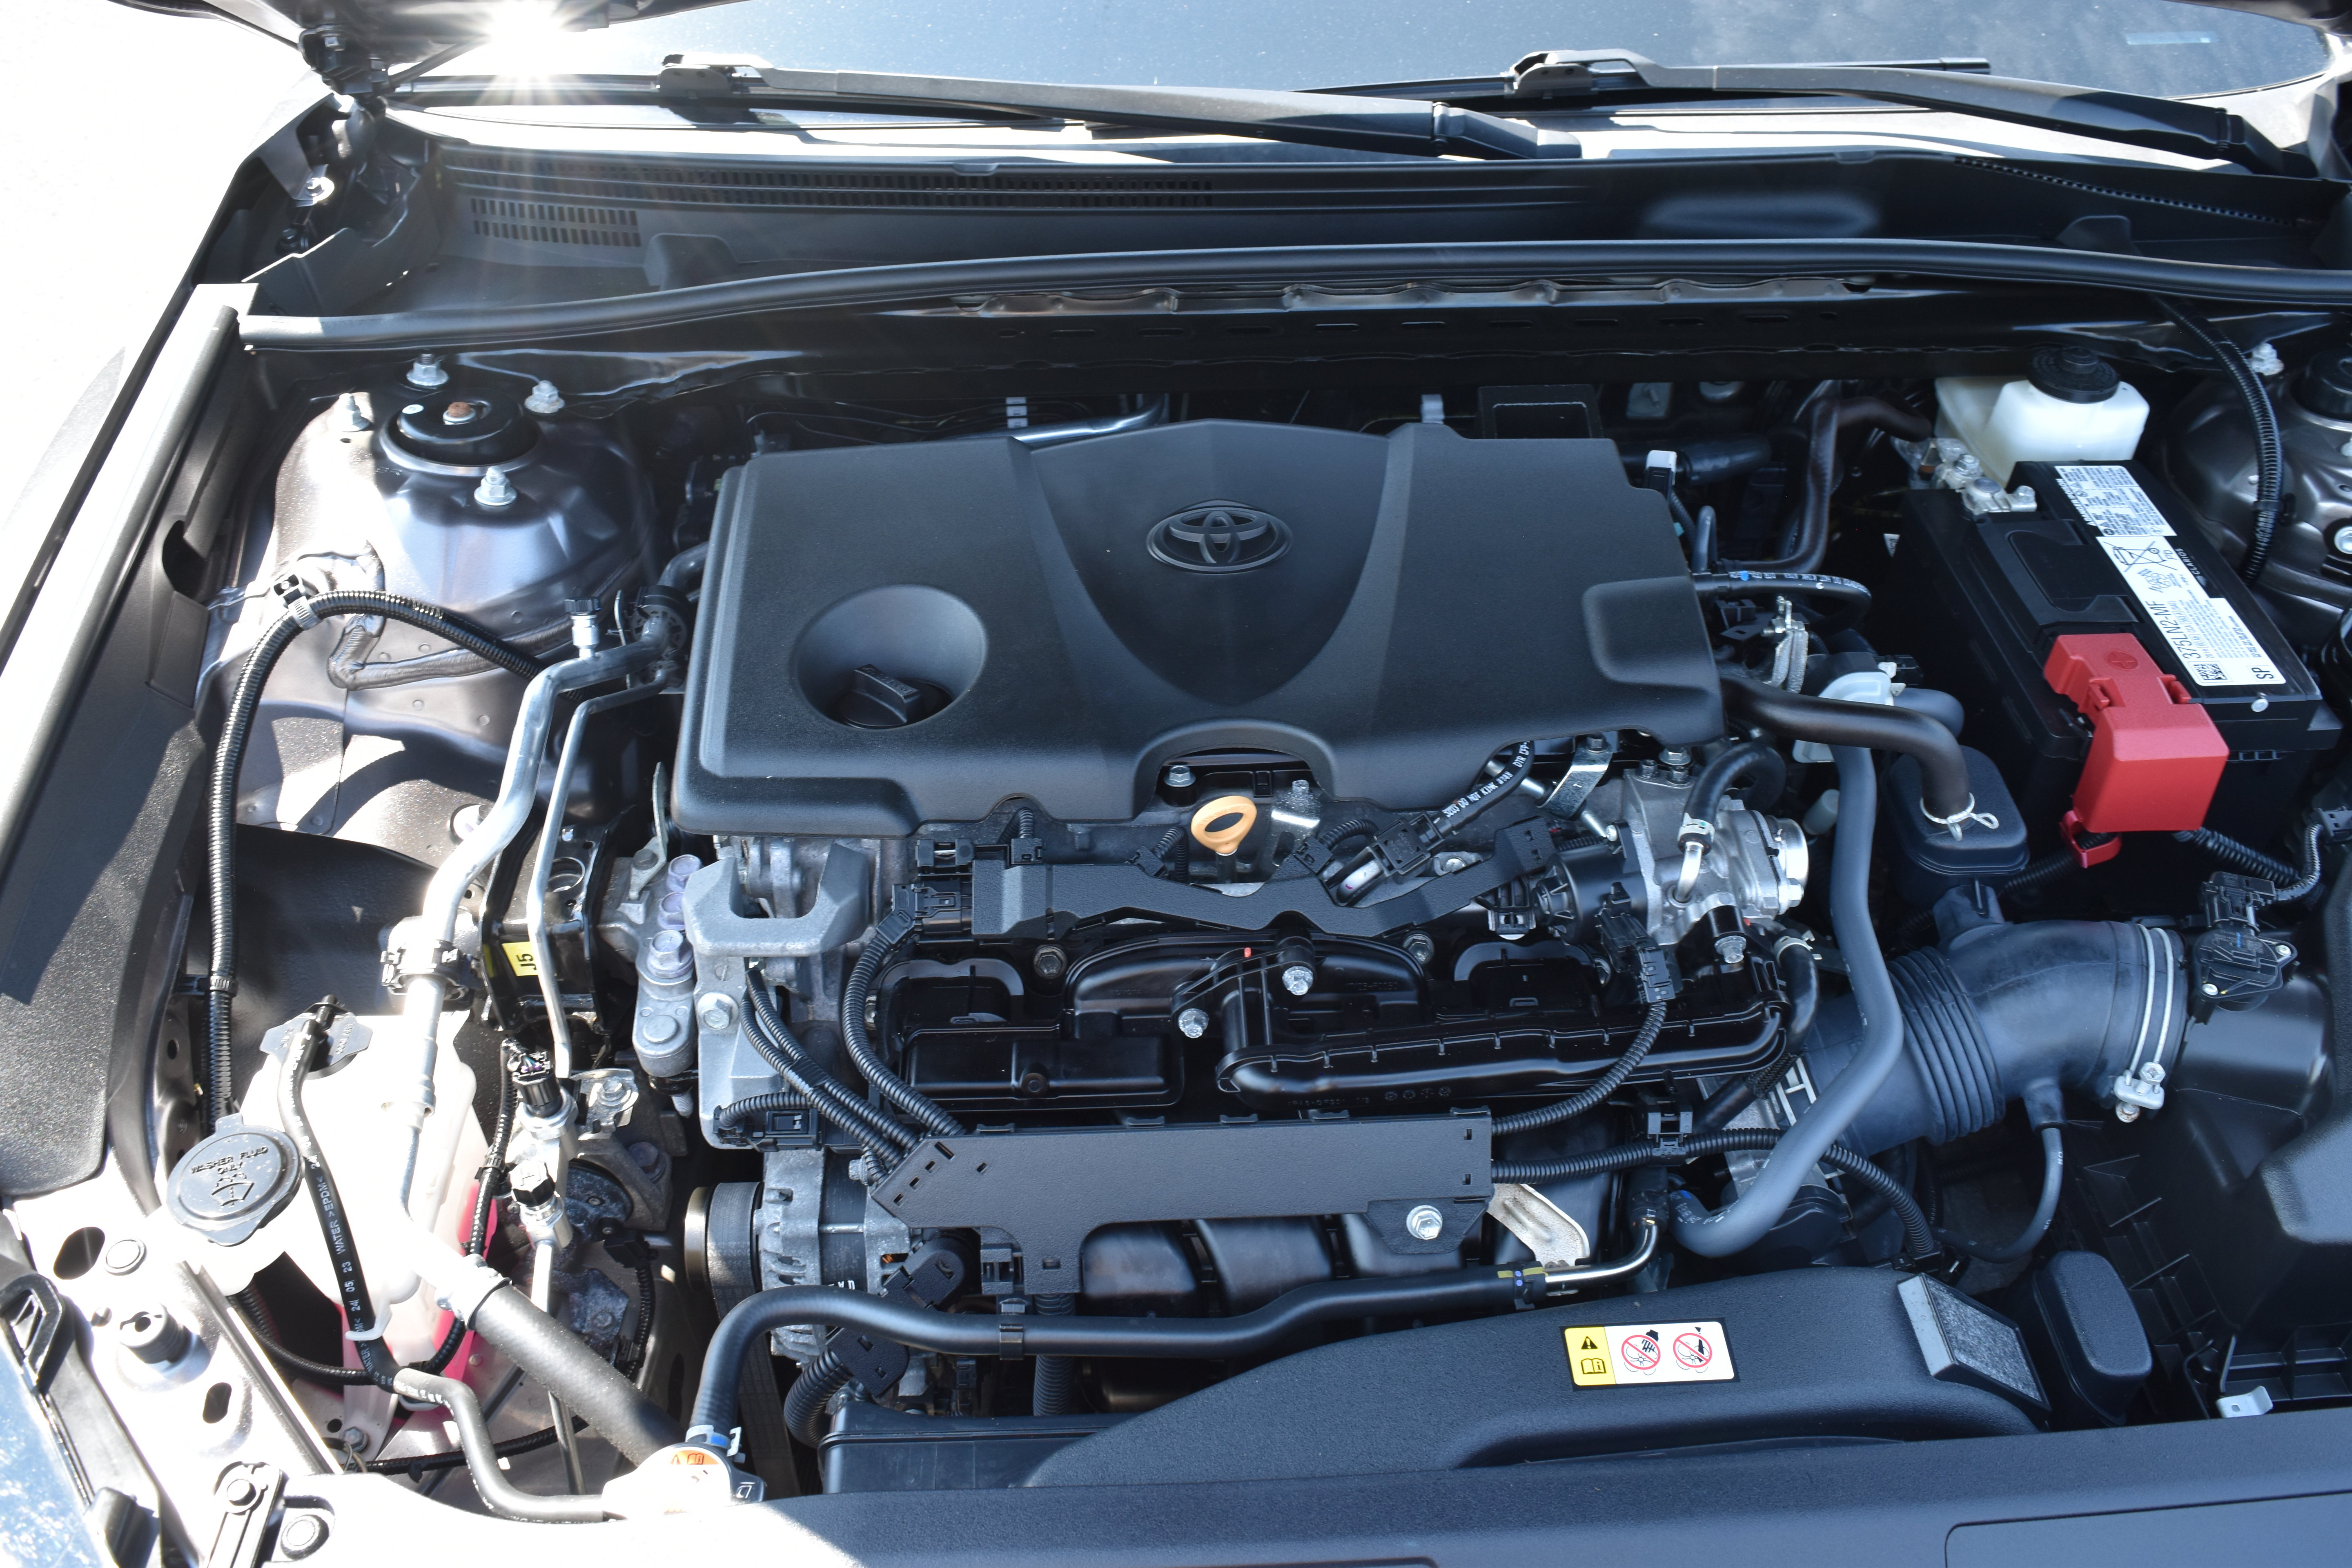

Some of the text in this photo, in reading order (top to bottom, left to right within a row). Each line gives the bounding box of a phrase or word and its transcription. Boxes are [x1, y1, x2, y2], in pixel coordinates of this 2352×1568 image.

[2176, 548, 2201, 575] CLARIOS
[2145, 601, 2201, 659] 375LN2-MF
[2252, 667, 2274, 679] SP
[1479, 782, 1499, 795] KINK
[516, 953, 538, 971] J5
[190, 1145, 269, 1174] WASHER FLUID
[217, 1161, 243, 1175] ONLY
[330, 1220, 346, 1255] WATER
[343, 1261, 353, 1274] 23
